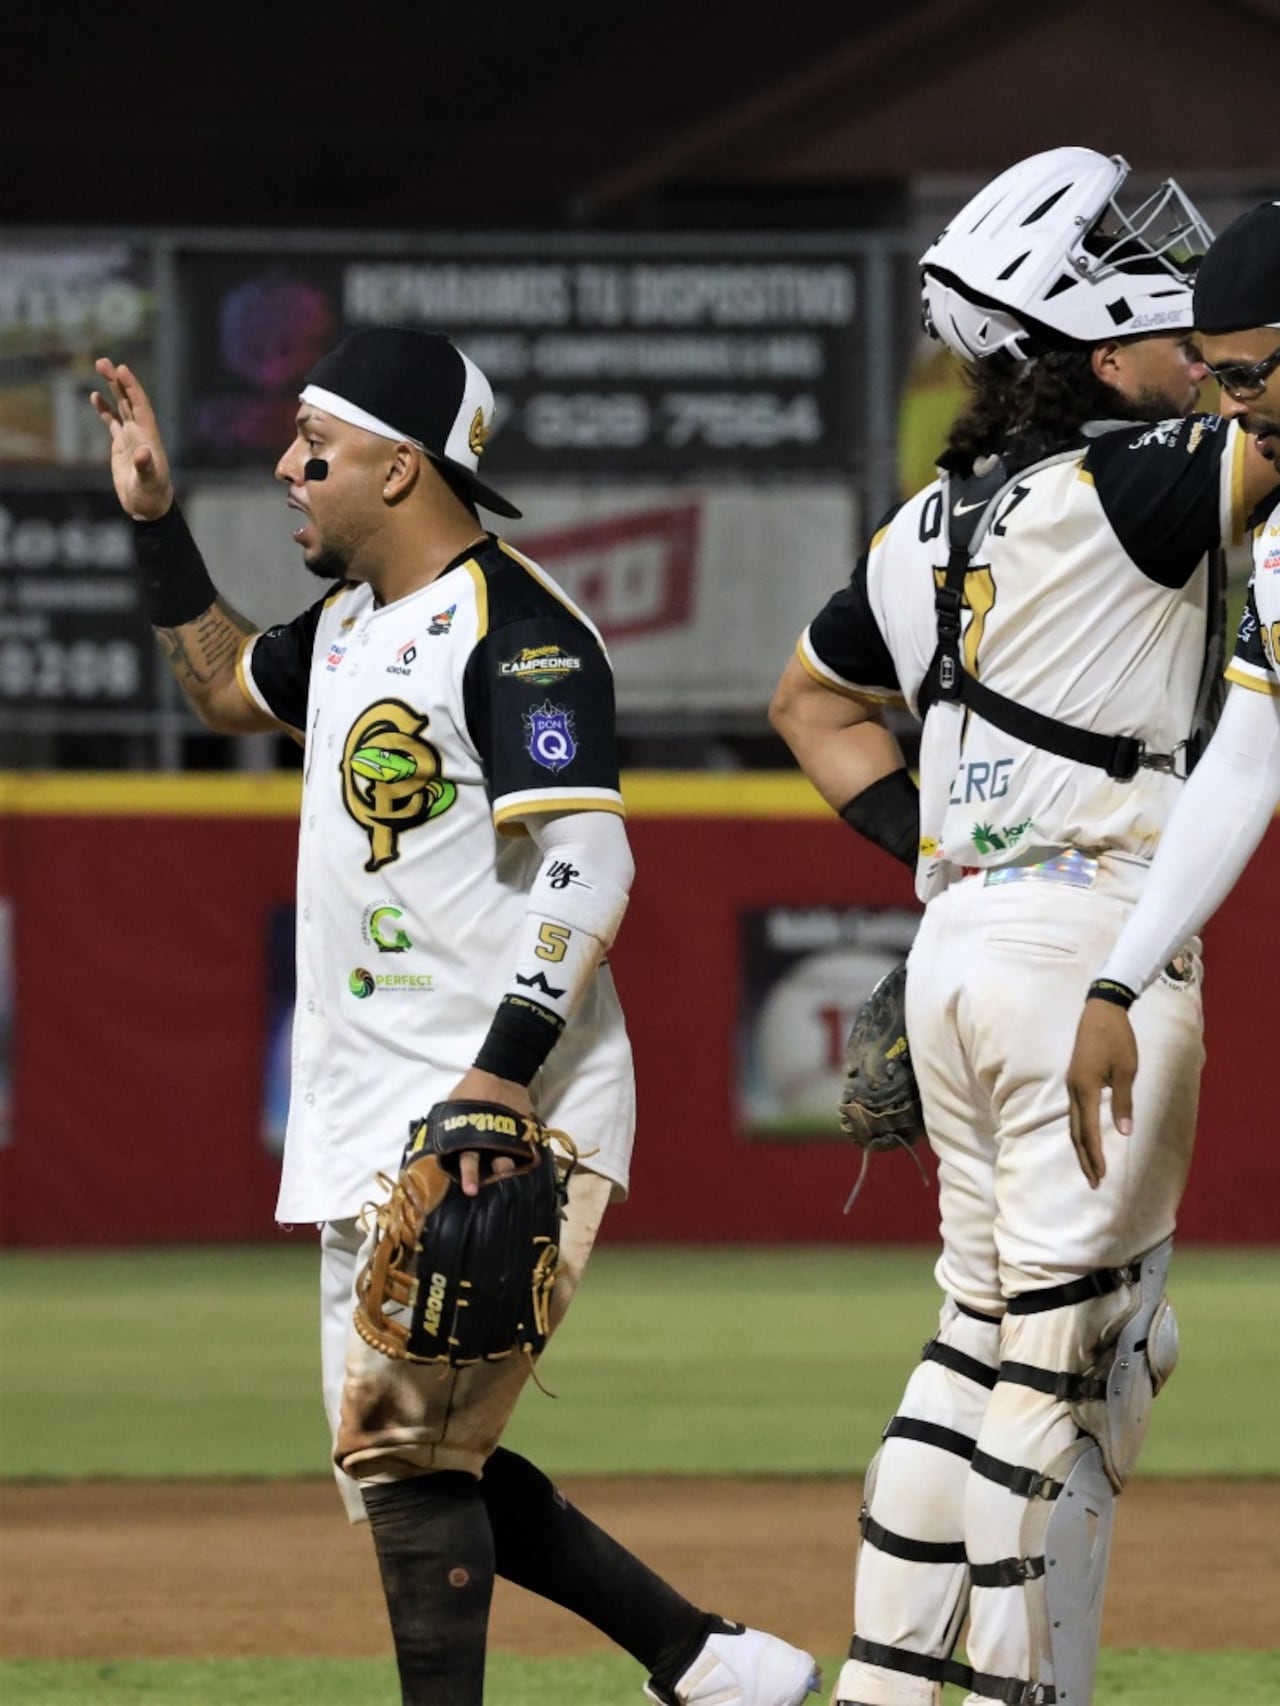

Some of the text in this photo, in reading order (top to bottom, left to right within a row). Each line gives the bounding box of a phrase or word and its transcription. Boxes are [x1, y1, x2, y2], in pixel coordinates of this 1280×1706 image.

[502, 658, 580, 673] CAMPEONES
[538, 720, 562, 730] DON
[537, 731, 569, 760] Q
[535, 922, 572, 963] 5
[376, 975, 432, 986] PERFECT
[443, 1112, 518, 1136] Wilson
[423, 1272, 448, 1337] A2000
